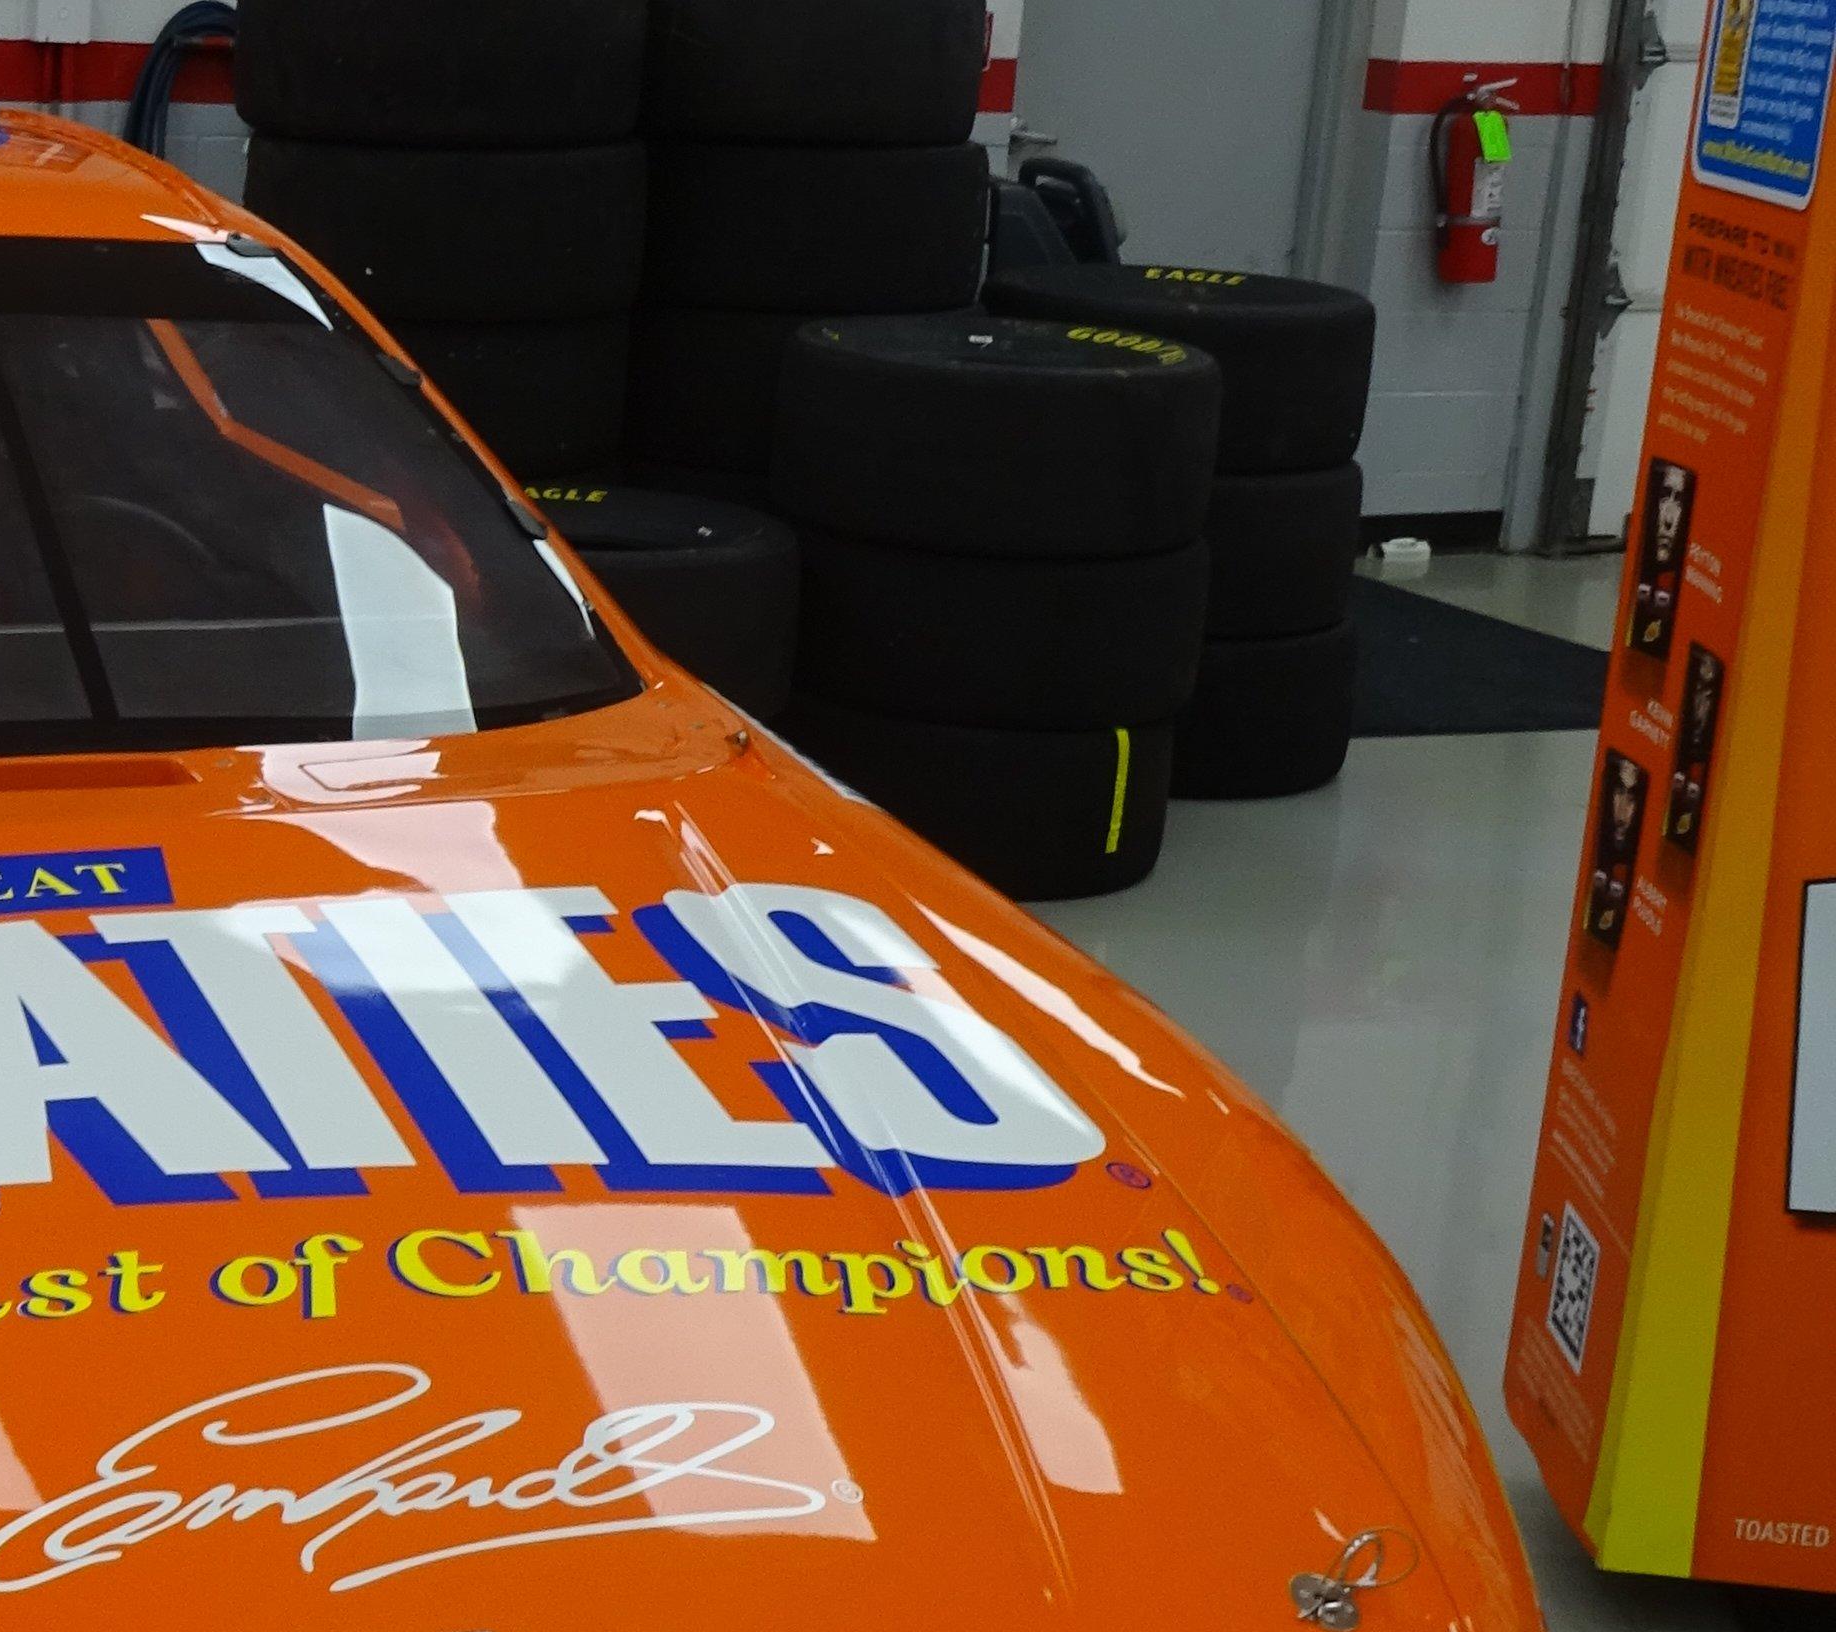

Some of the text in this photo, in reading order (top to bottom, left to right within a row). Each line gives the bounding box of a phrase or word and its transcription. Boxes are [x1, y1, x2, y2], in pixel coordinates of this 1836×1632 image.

[1144, 267, 1248, 288] EAGLE
[524, 486, 609, 504] AGLE
[211, 1230, 364, 1322] of
[387, 1226, 1222, 1317] Champions!
[1734, 1516, 1831, 1548] TOASTED
